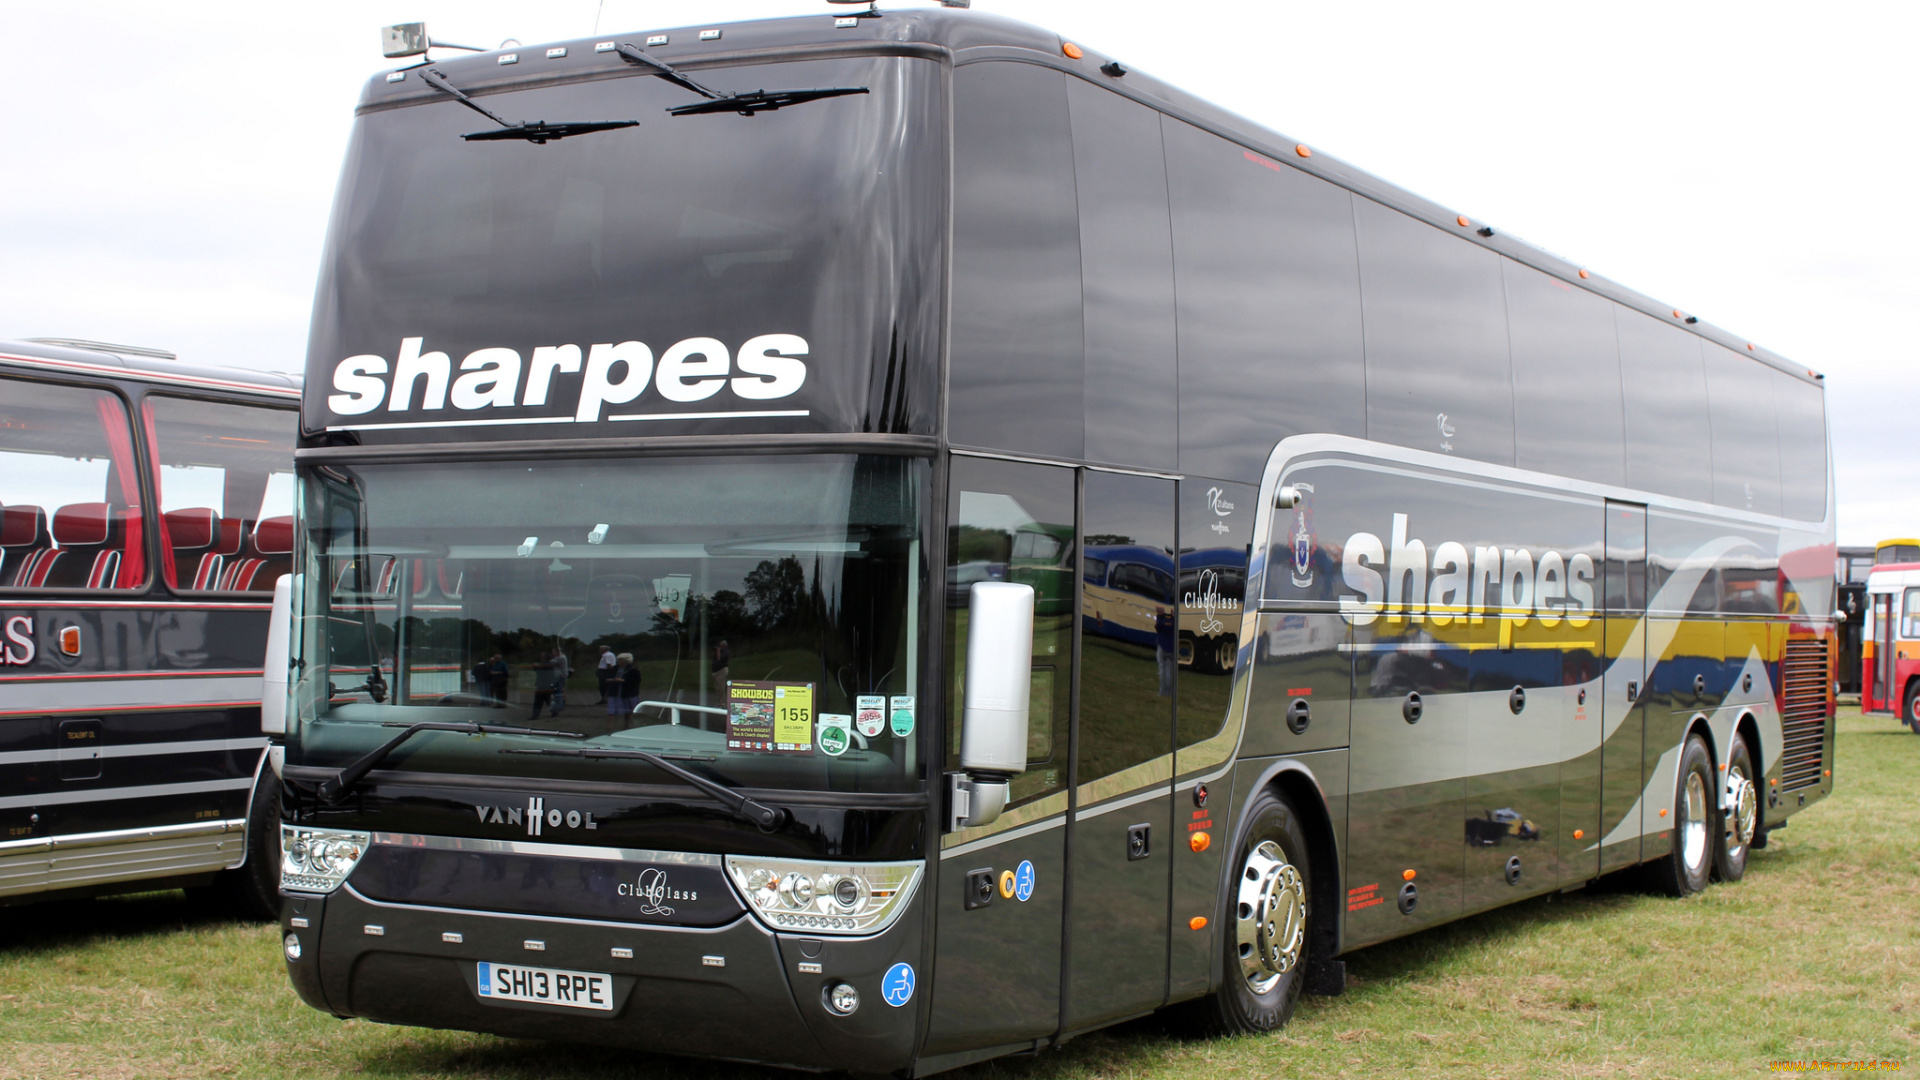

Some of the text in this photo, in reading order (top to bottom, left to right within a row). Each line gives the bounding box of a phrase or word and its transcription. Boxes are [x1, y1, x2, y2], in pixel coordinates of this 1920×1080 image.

[327, 333, 810, 423] sharpes
[1338, 512, 1596, 650] sharpes
[0, 614, 36, 665] S
[731, 688, 774, 700] SHOWBUS
[780, 707, 809, 722] 155
[480, 984, 490, 993] GB
[496, 967, 605, 1005] SH13 RPE
